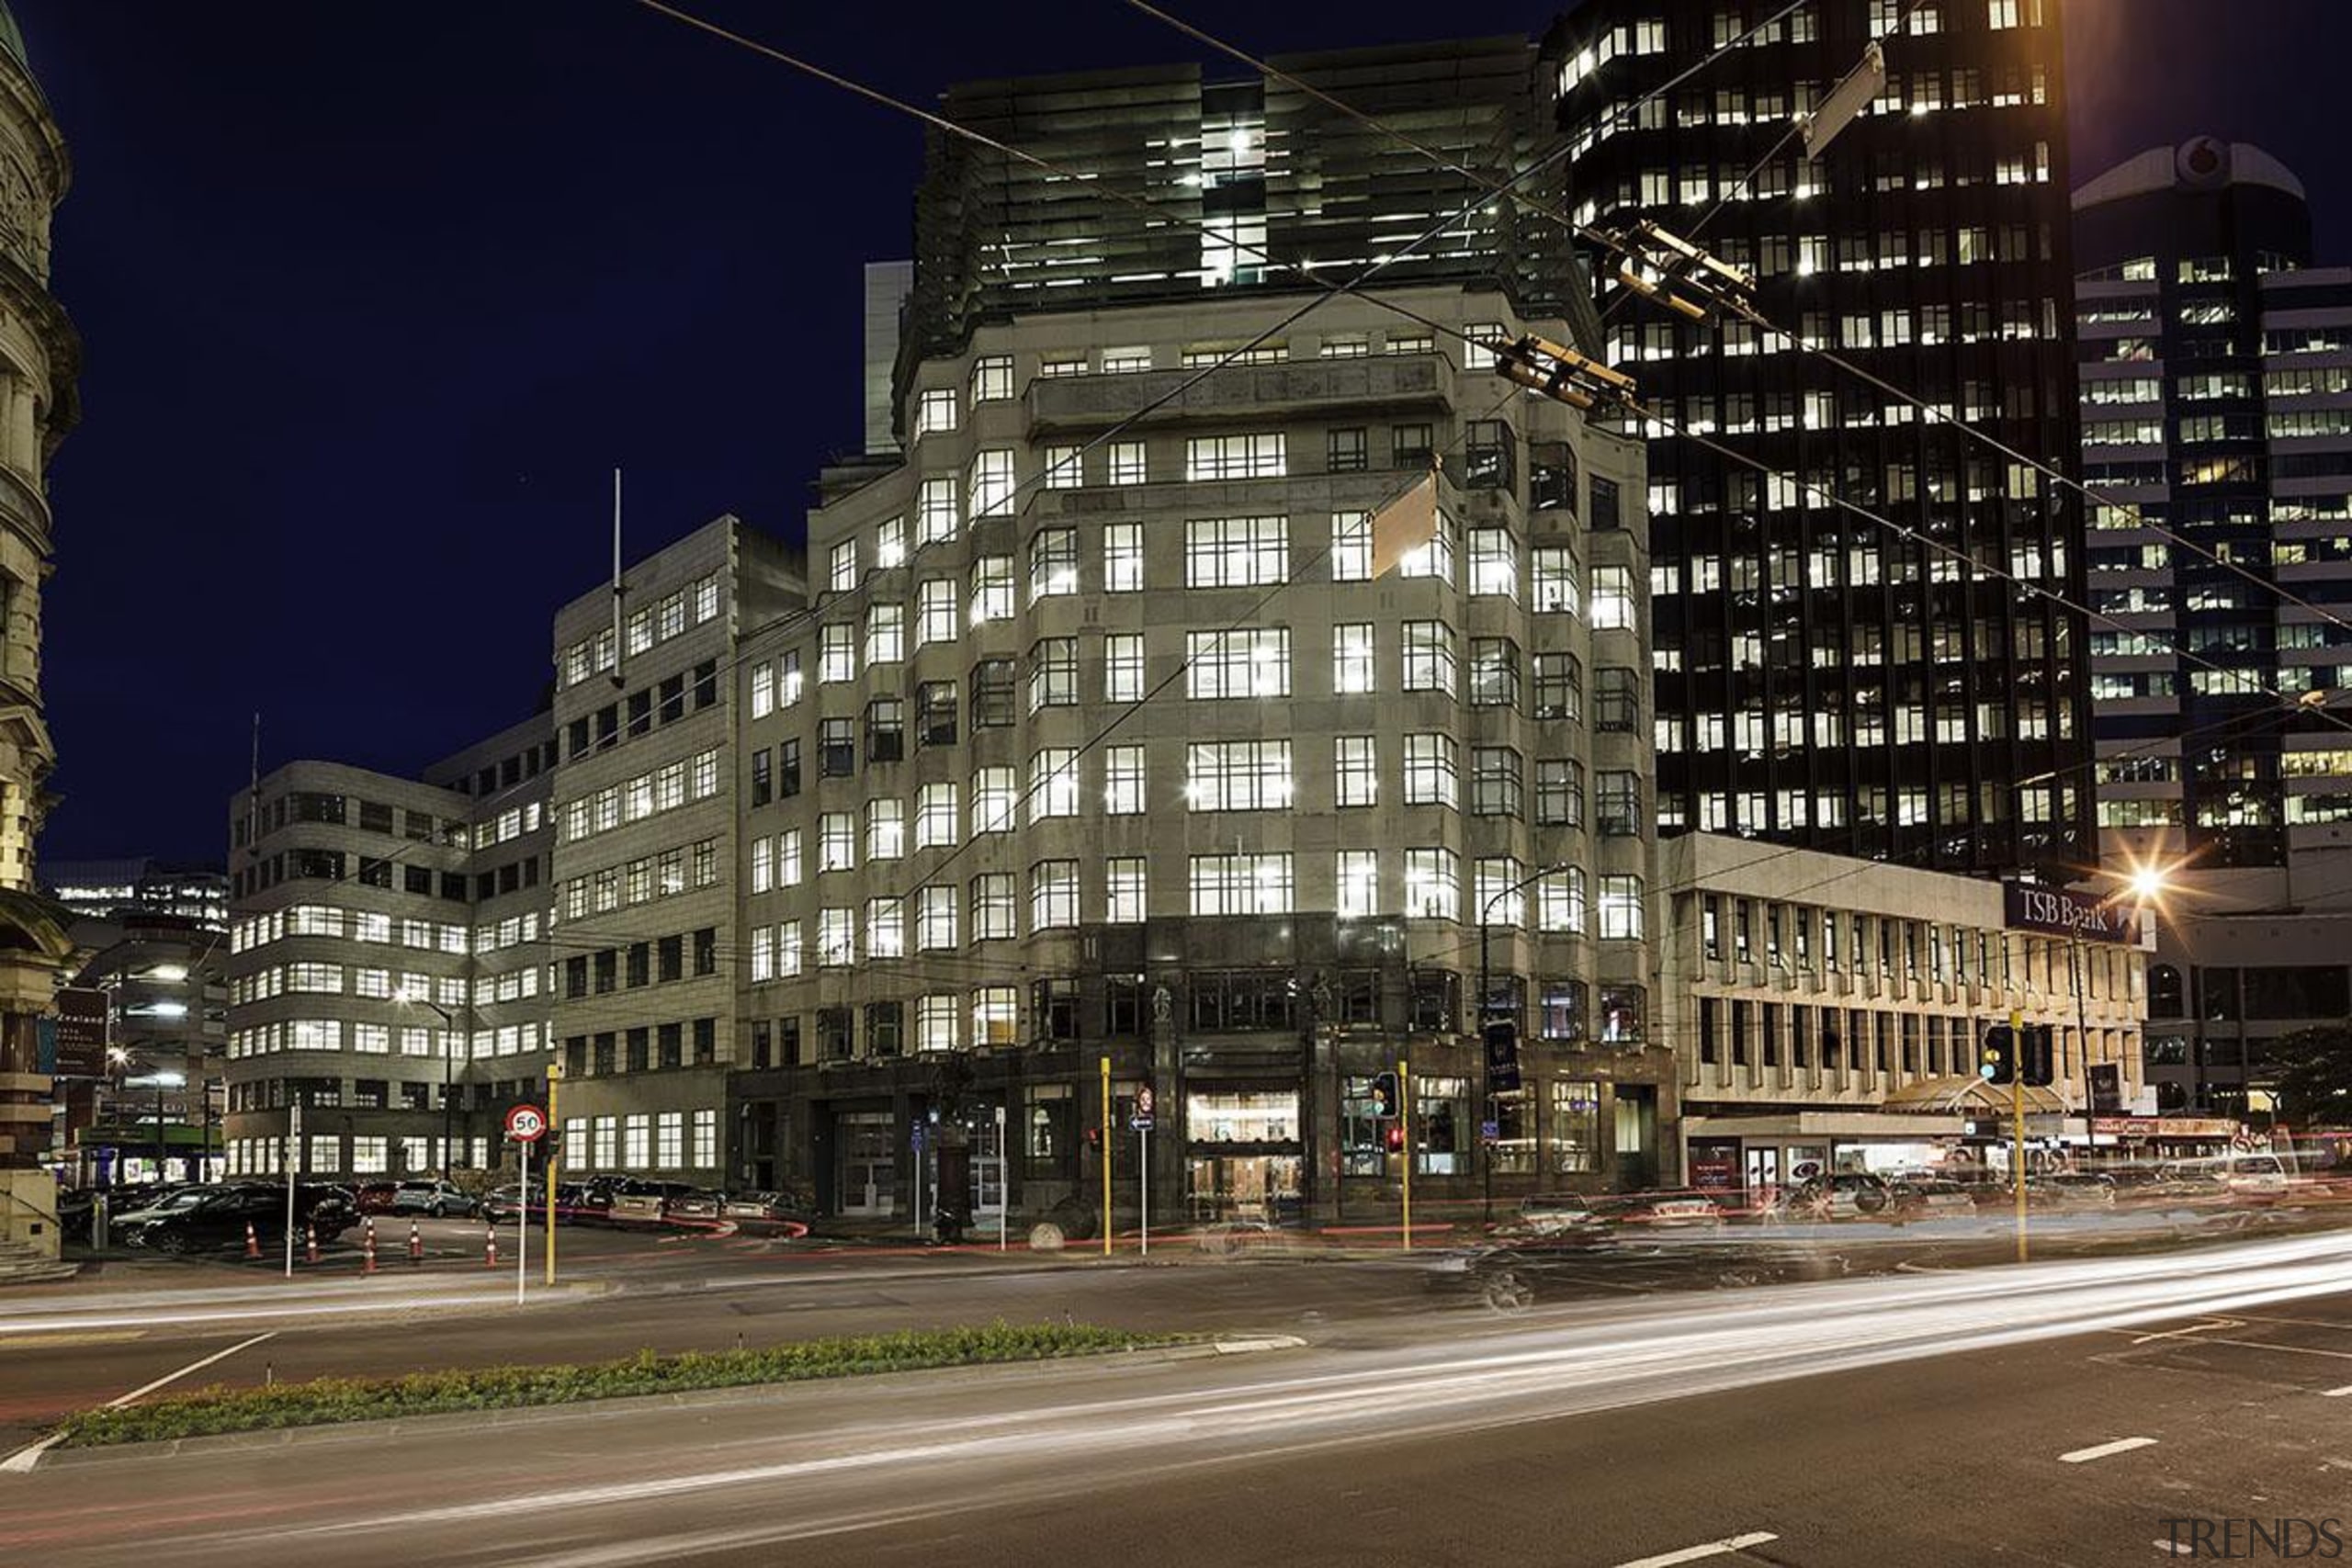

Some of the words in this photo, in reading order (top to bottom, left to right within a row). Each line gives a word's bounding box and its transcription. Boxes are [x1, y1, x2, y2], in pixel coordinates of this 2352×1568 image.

[2018, 888, 2059, 924] TSB
[2061, 896, 2108, 932] Bank
[516, 1116, 537, 1130] 50
